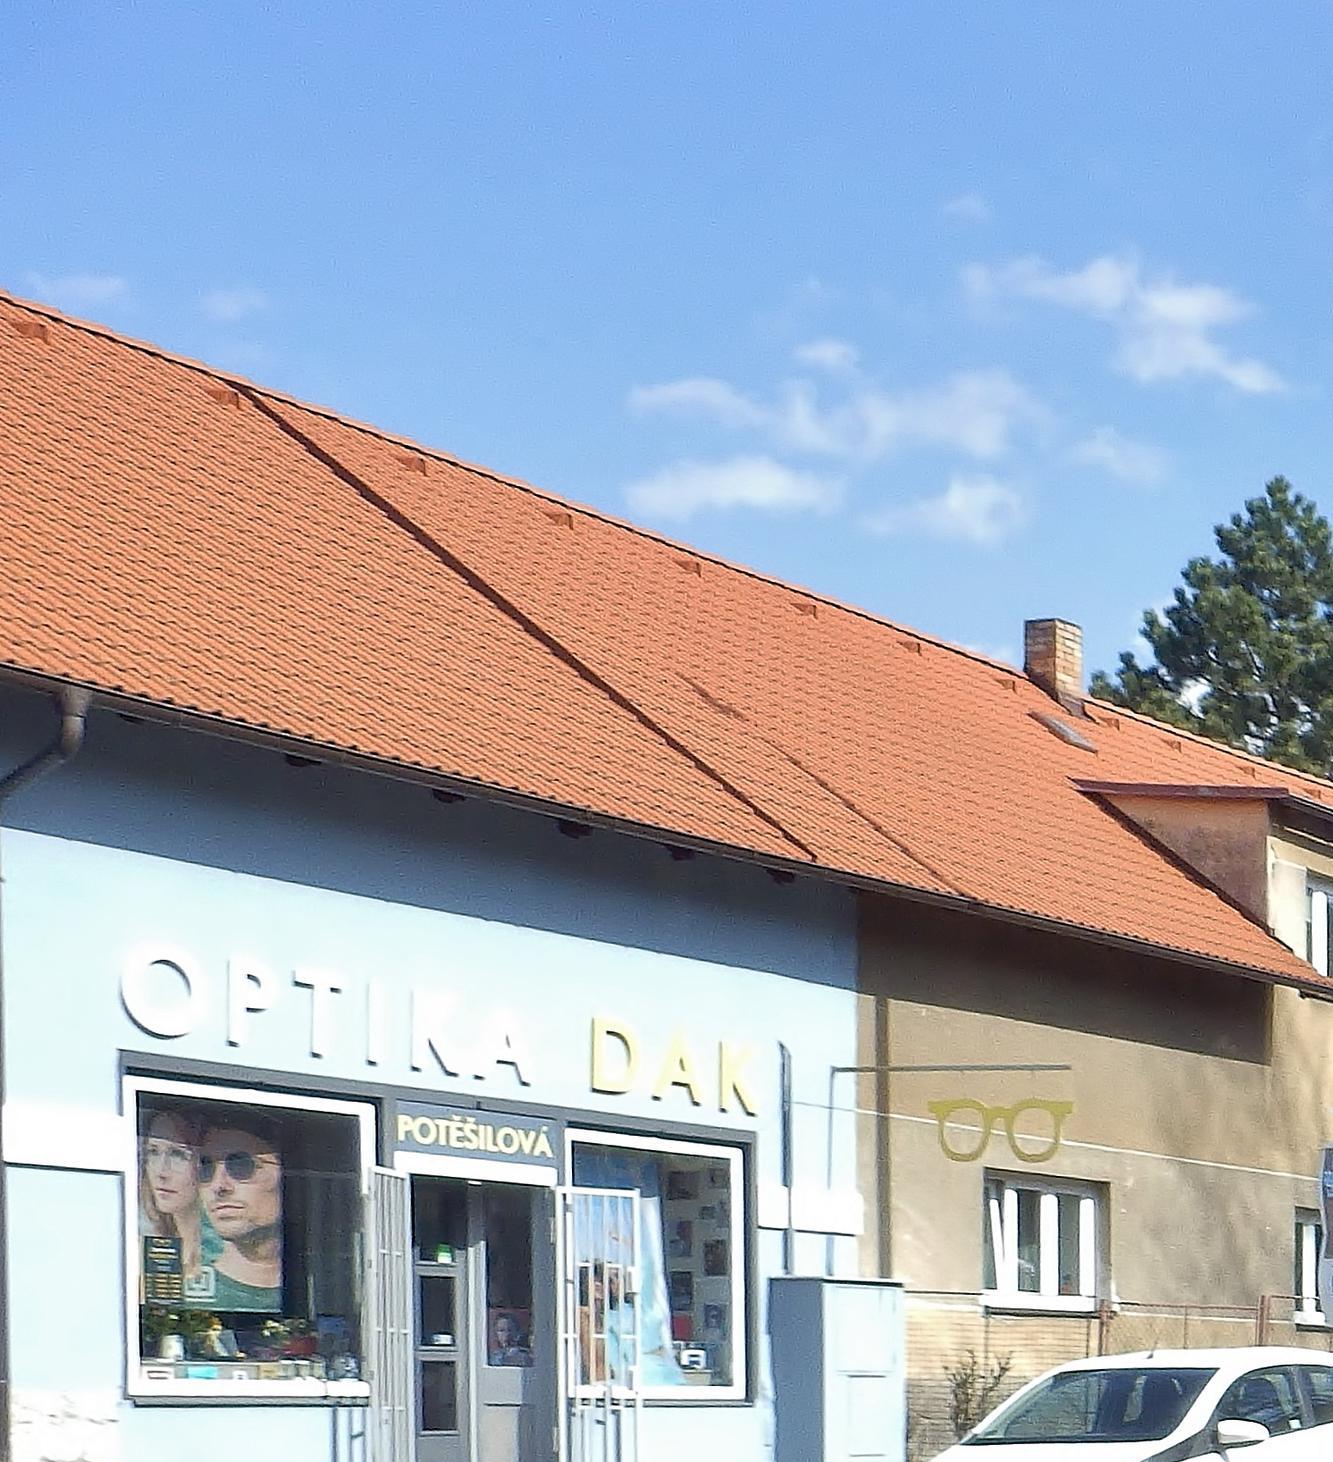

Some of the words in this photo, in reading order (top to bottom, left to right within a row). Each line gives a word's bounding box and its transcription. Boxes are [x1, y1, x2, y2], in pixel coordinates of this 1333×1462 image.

[119, 954, 531, 1087] OPTIKA
[590, 1016, 758, 1118] DAK
[396, 1114, 554, 1159] POTĚŠILOVÁ
